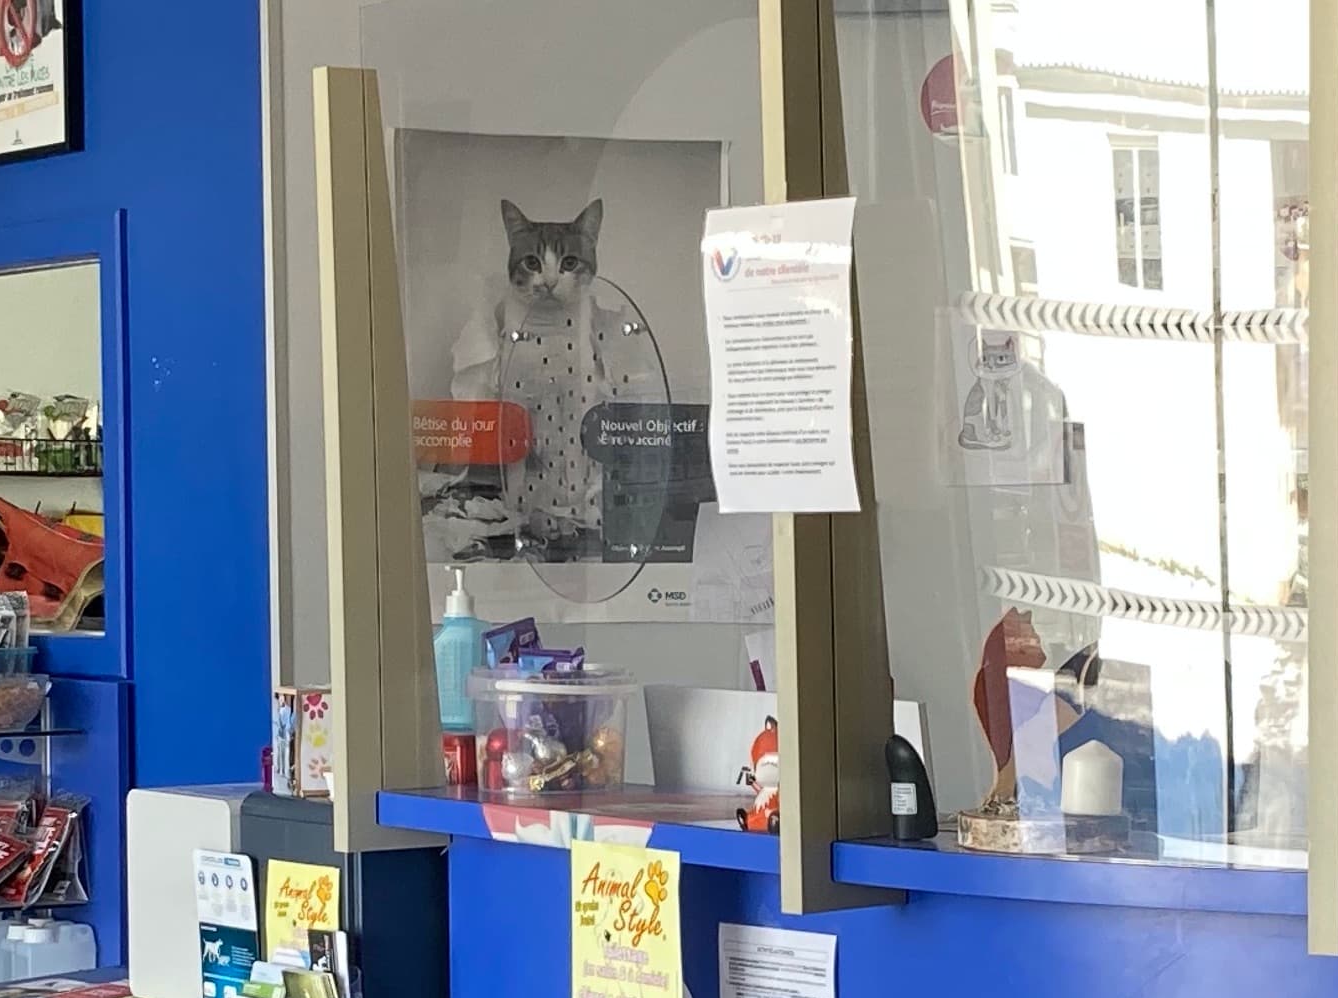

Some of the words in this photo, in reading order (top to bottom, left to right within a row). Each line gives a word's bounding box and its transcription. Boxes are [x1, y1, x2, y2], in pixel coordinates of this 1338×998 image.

[413, 415, 448, 431] Bêtise
[451, 418, 468, 432] du
[471, 418, 497, 435] jour
[600, 419, 644, 433] Nouvel
[646, 418, 697, 435] Objectif
[582, 861, 644, 899] Animal
[613, 899, 663, 947] Style
